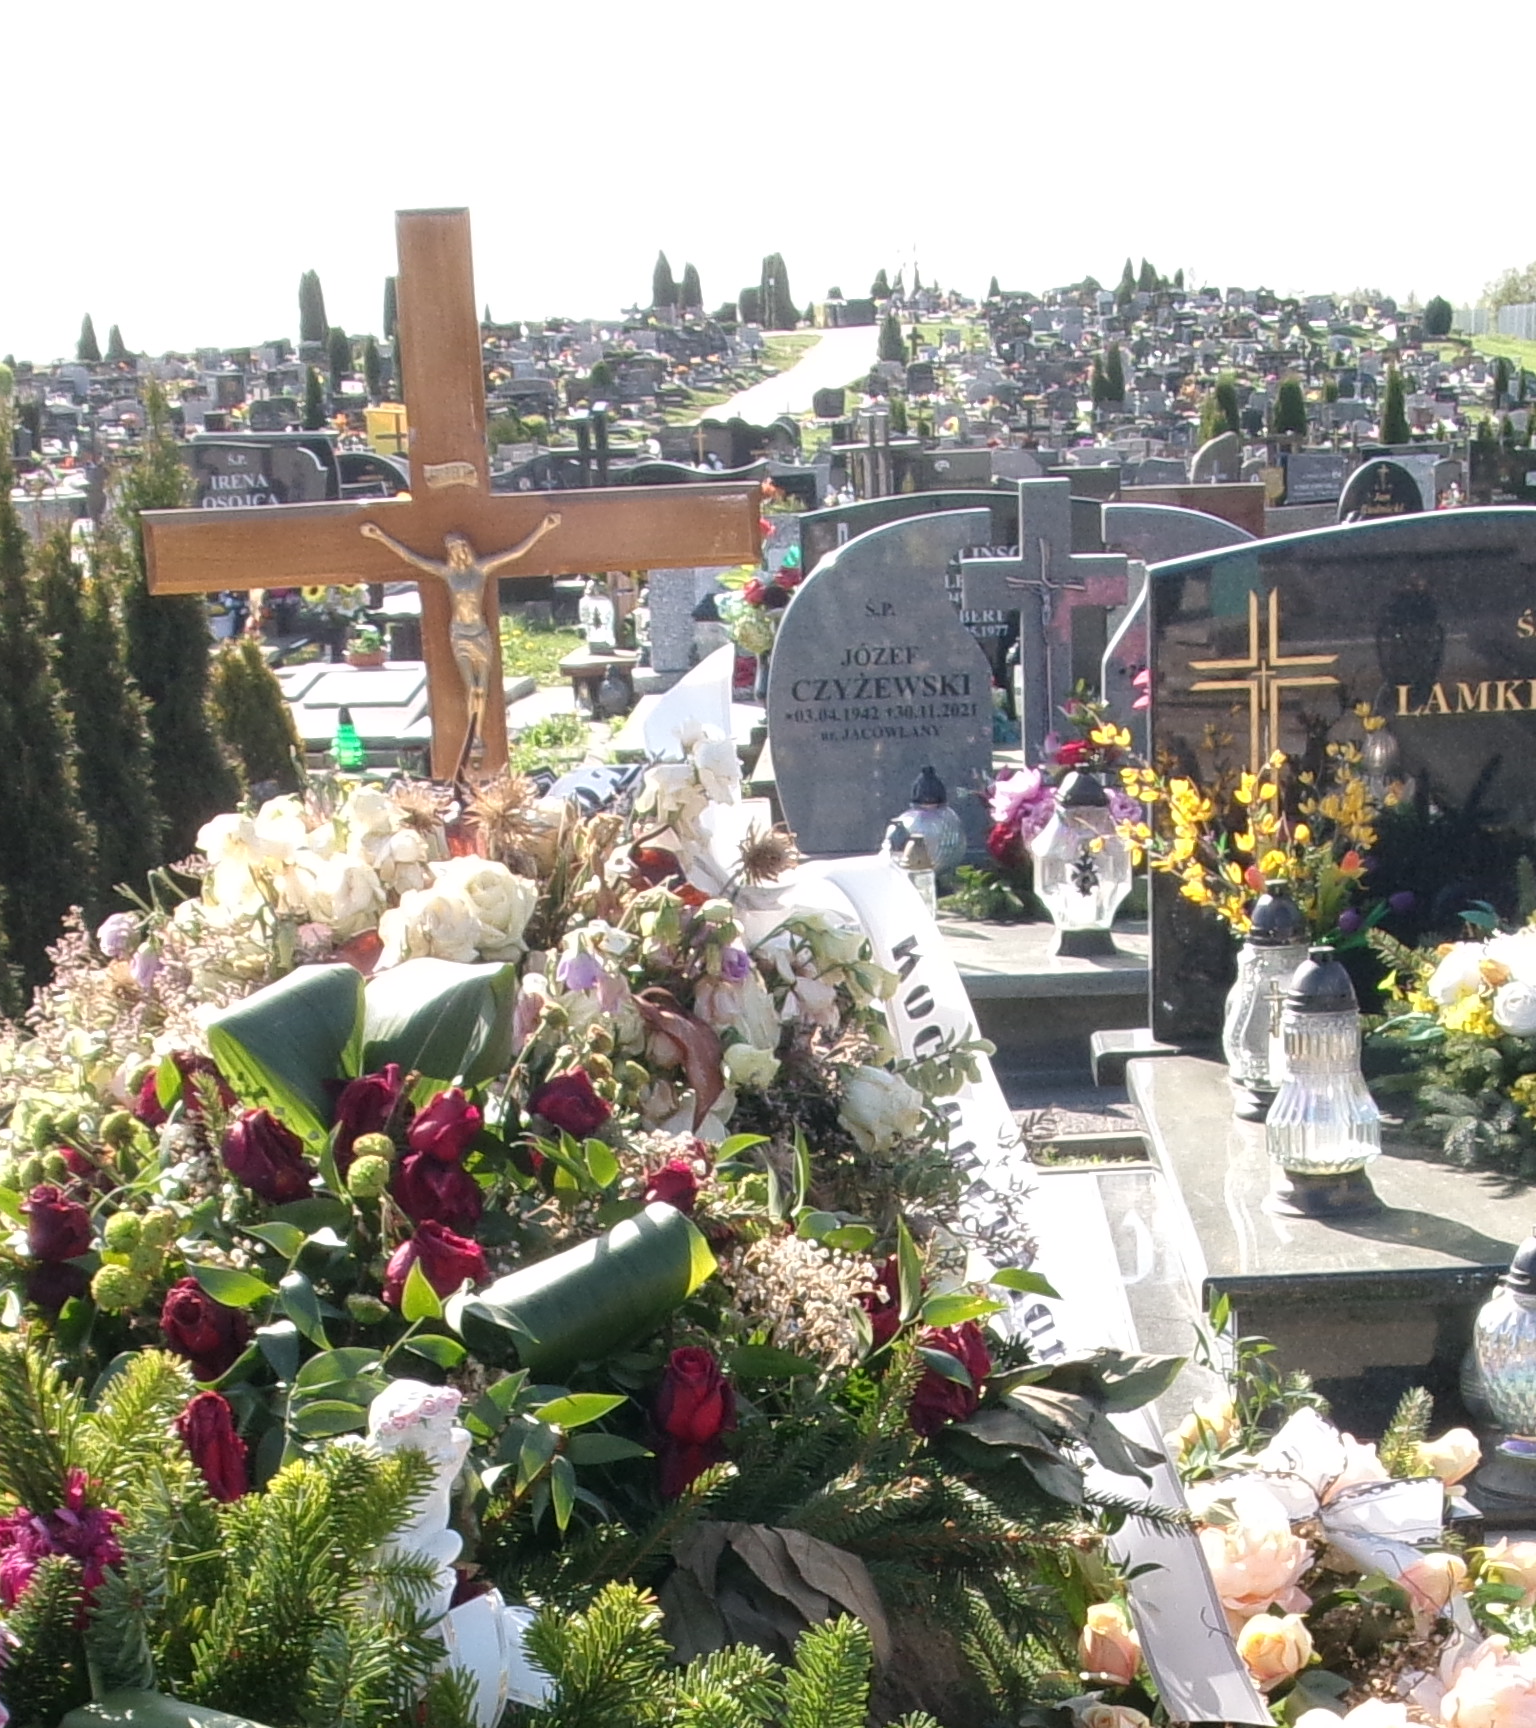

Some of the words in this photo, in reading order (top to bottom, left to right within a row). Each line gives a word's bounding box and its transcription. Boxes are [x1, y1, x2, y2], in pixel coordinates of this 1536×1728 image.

[211, 473, 268, 490] IRENA
[841, 642, 918, 666] JÓZEF
[791, 671, 971, 701] CZYŻEWSKI
